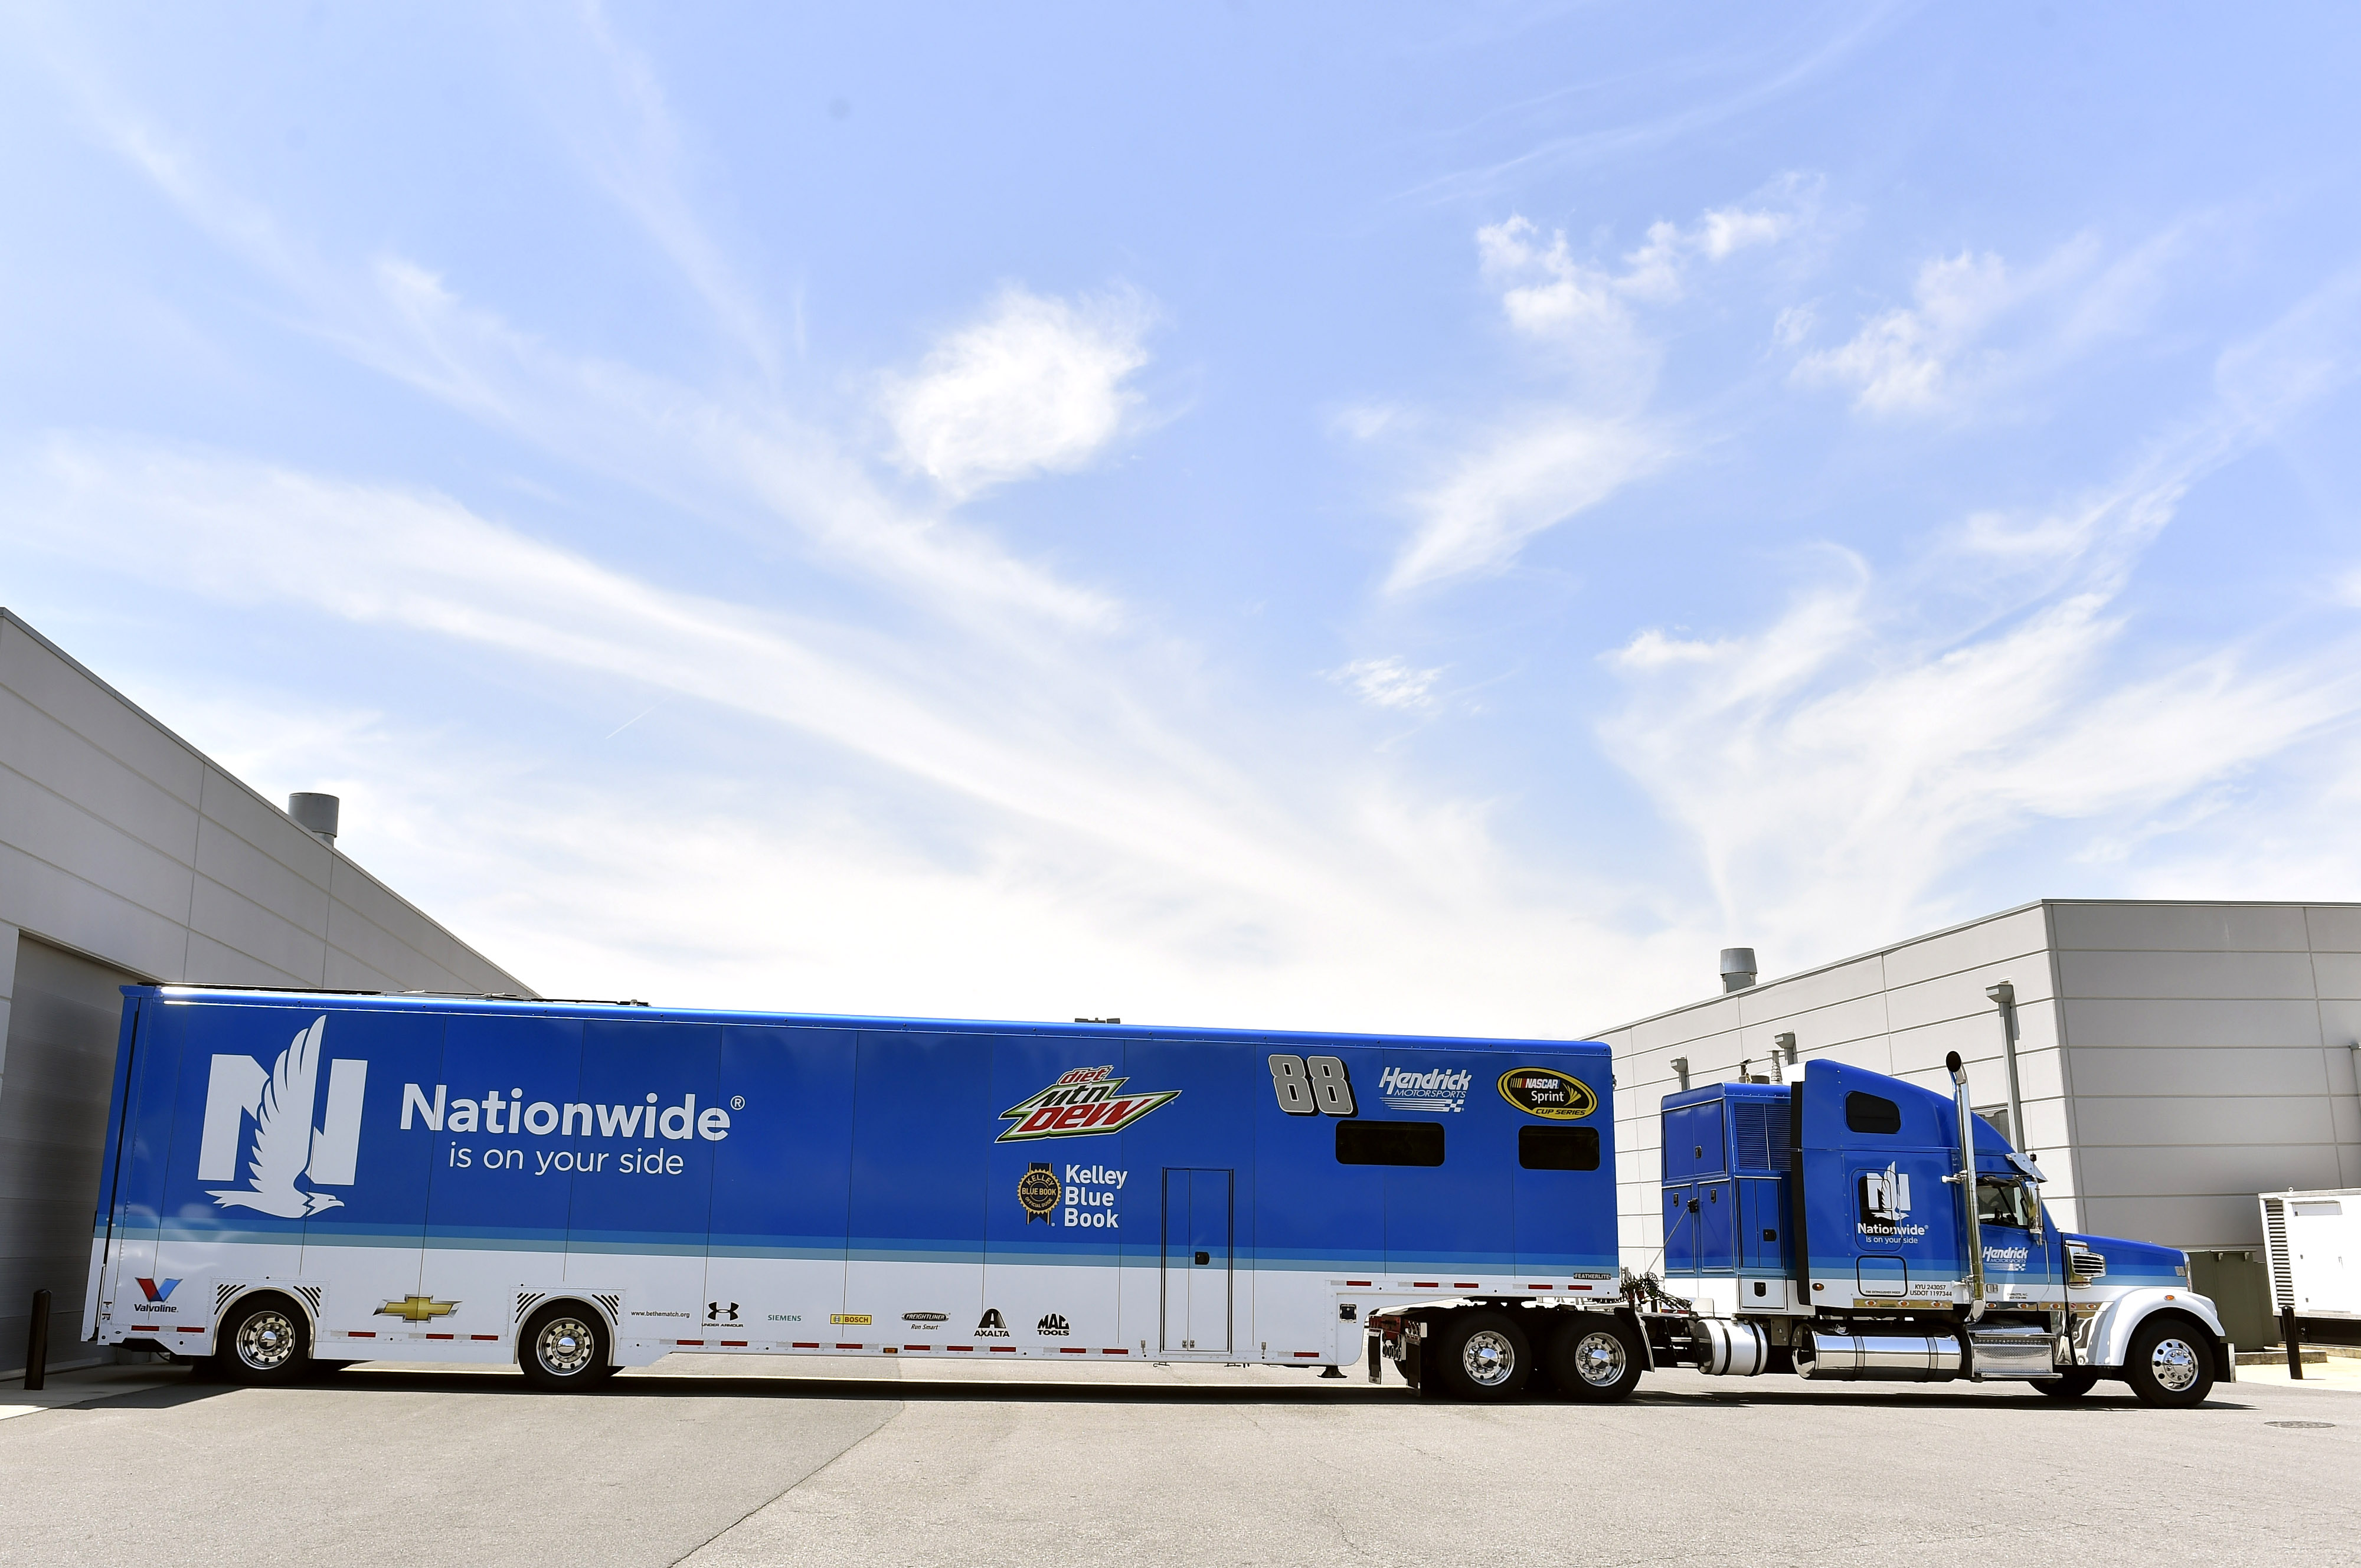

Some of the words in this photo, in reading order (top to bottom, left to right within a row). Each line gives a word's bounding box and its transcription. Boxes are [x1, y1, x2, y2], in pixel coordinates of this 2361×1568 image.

[1059, 1067, 1110, 1085] diet
[1378, 1067, 1472, 1095] Hendrick
[1525, 1078, 1559, 1089] NASCAR
[1268, 1054, 1357, 1116] 88
[1025, 1084, 1111, 1109] Mtn
[1393, 1089, 1467, 1099] MOTORSPORTS
[1531, 1090, 1565, 1104] Sprint
[449, 1141, 473, 1168] is
[483, 1148, 524, 1170] on
[534, 1150, 610, 1176] your
[618, 1147, 684, 1174] side
[1026, 1174, 1055, 1186] KELLEY
[1065, 1164, 1128, 1189] Kelley
[1065, 1186, 1114, 1207] Blue
[1064, 1207, 1119, 1228] Book
[1982, 1246, 2029, 1262] Hendrick
[133, 1304, 177, 1313] Valvoline
[630, 1310, 691, 1318] www.bethematch.org
[1037, 1314, 1070, 1329] MAC
